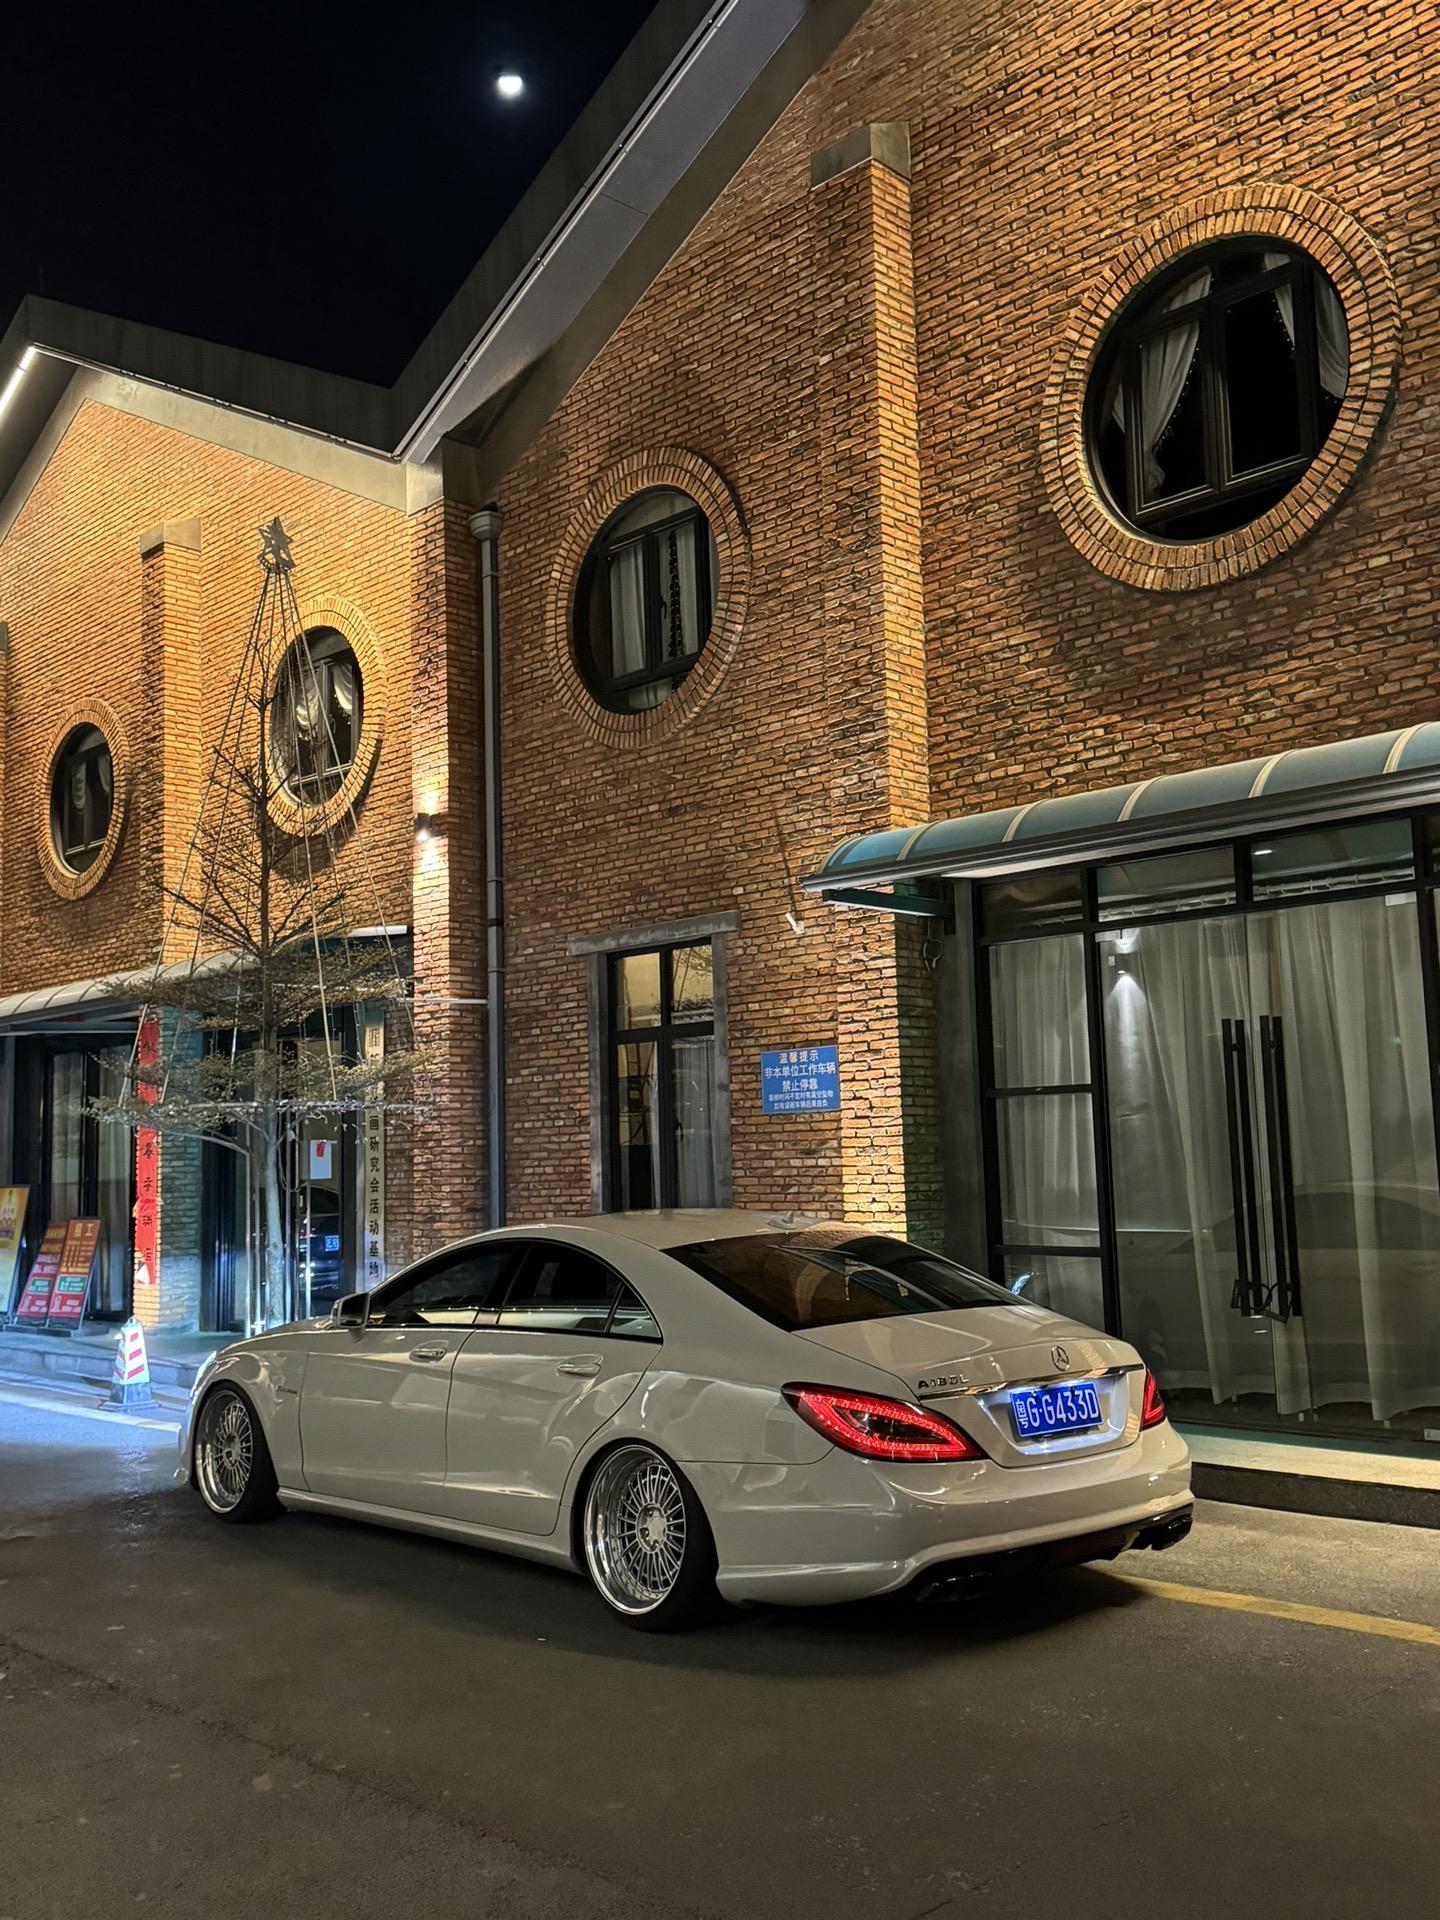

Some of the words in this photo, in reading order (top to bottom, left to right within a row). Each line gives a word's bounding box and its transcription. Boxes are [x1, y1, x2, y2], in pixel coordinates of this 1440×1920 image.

[779, 1050, 818, 1063] 温馨提示
[764, 1062, 836, 1078] 非本单位工作车辆
[782, 1078, 818, 1092] 禁止停靠
